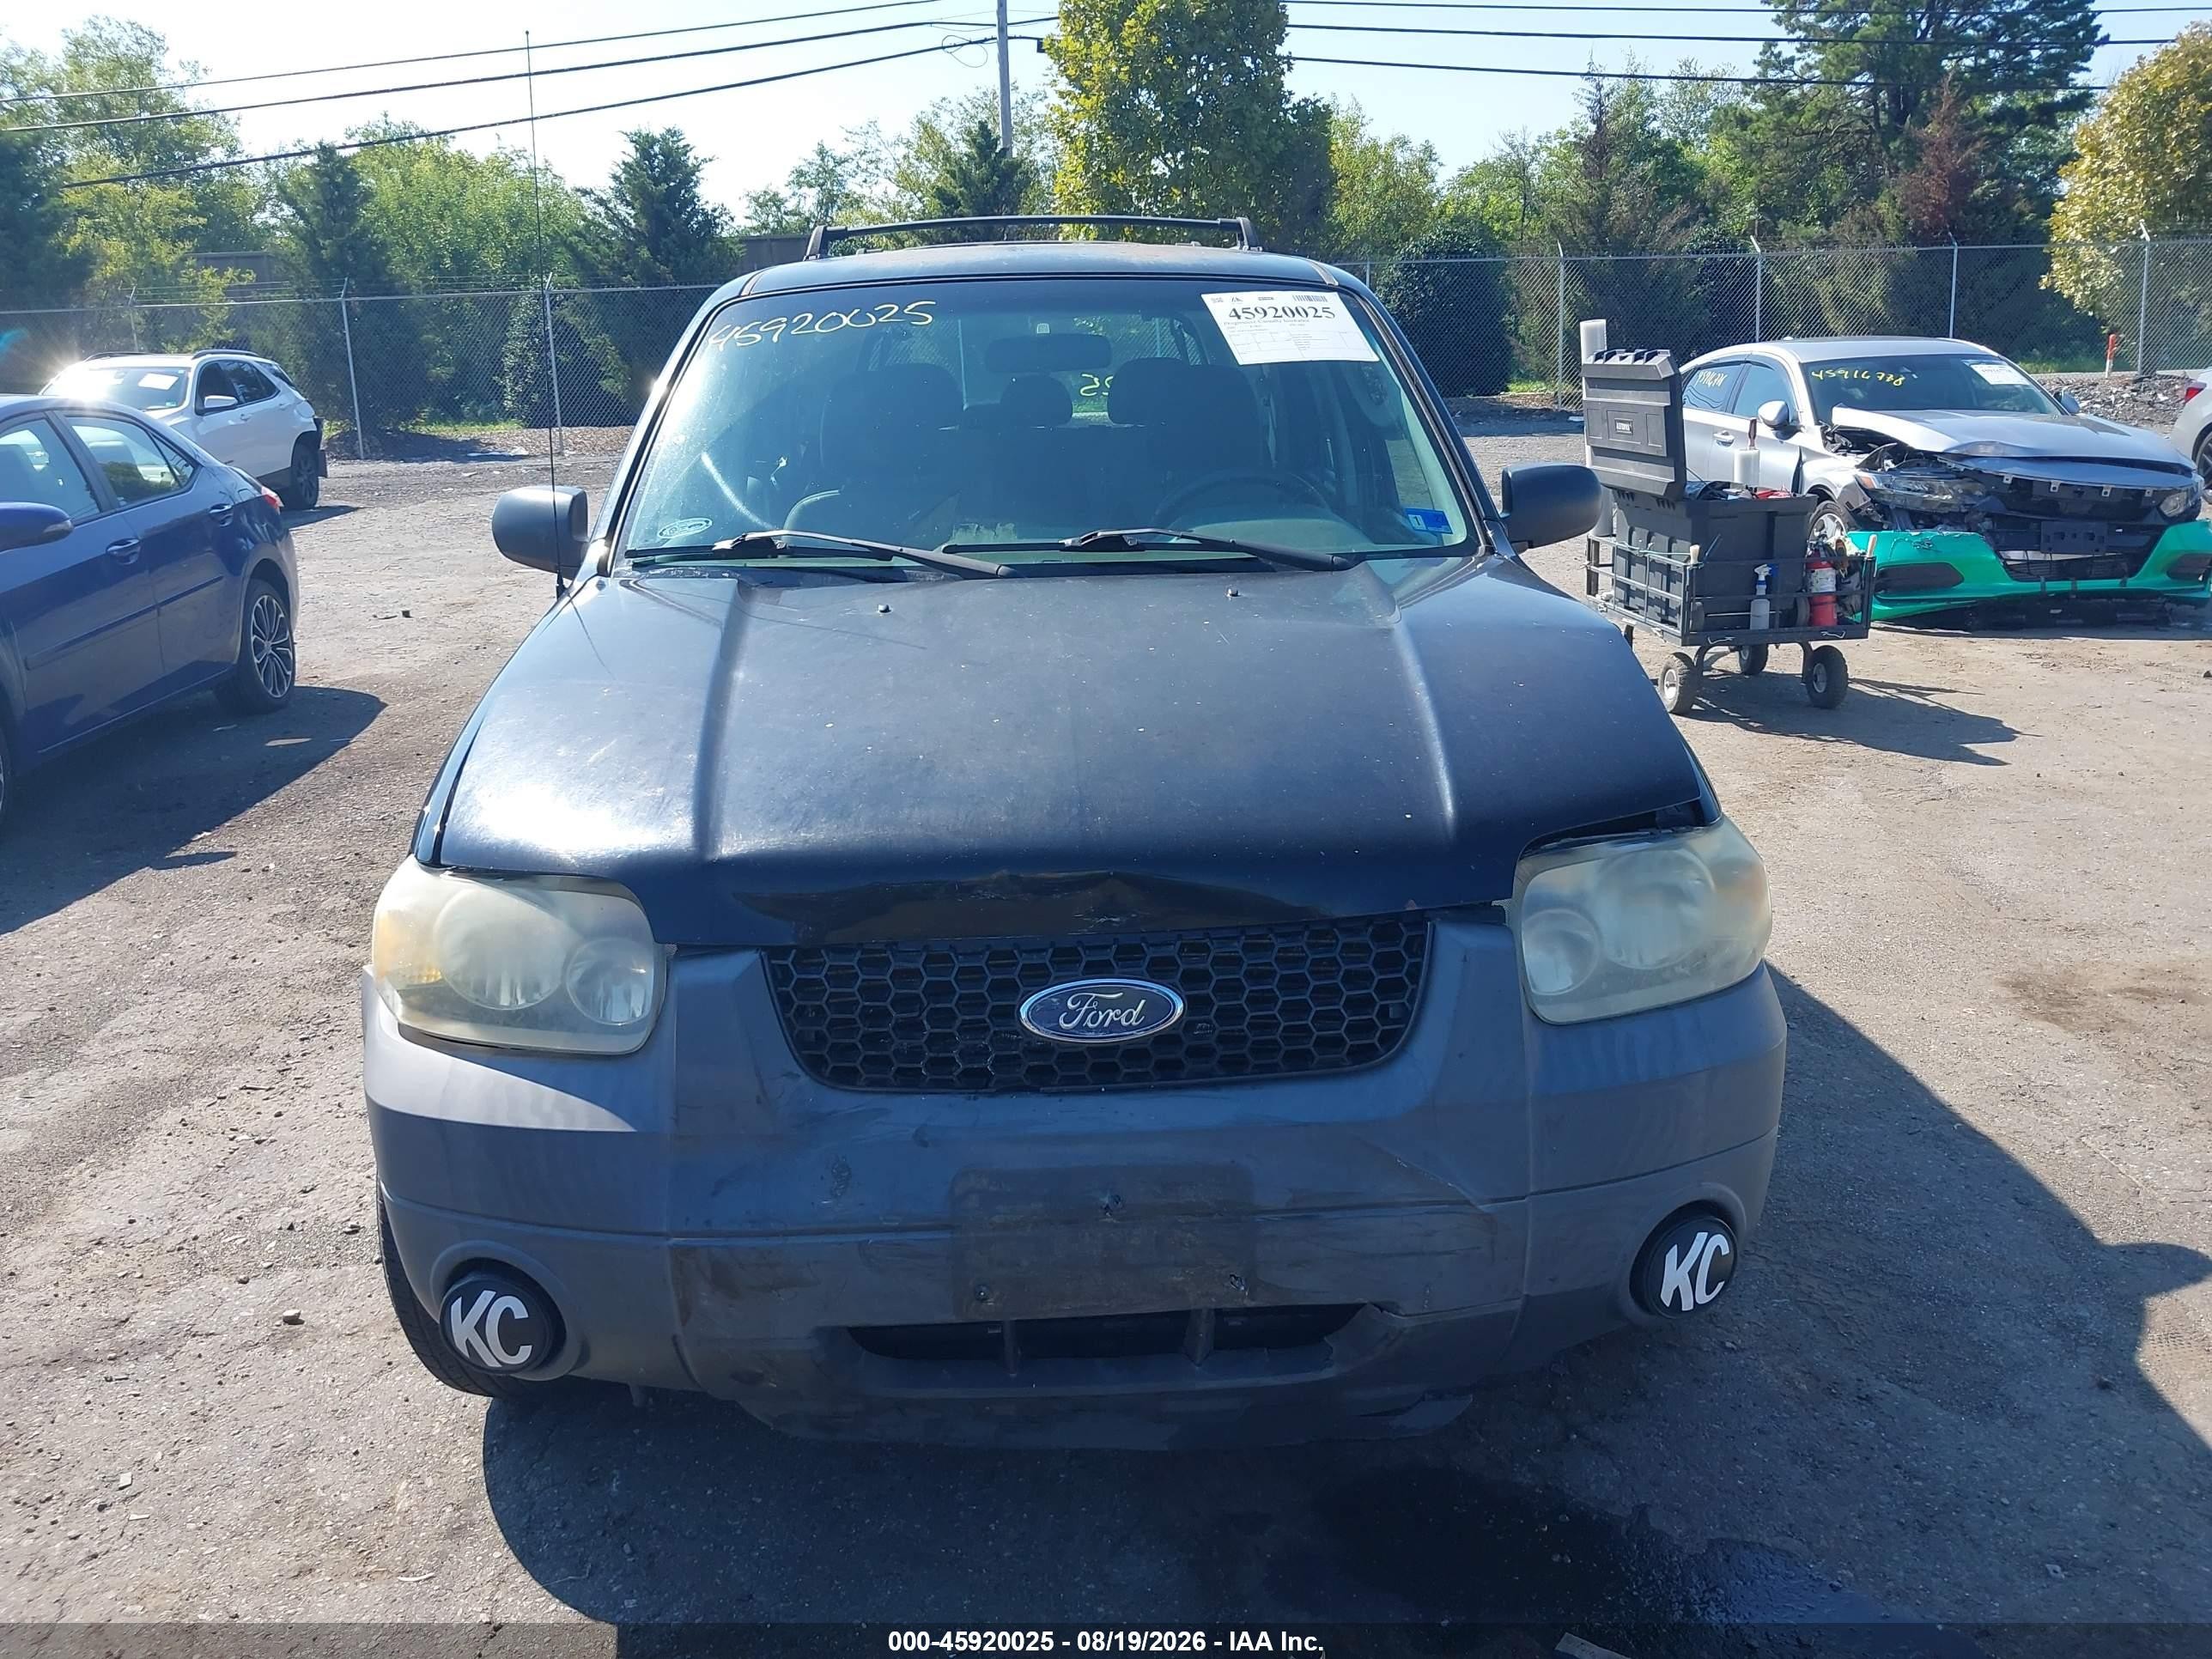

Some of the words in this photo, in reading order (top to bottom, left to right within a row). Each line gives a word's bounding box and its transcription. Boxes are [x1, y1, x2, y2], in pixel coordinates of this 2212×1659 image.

[708, 301, 936, 350] 45920025
[1229, 306, 1336, 320] 45920025
[1059, 992, 1146, 1030] Ford
[1660, 1231, 1730, 1311] KC
[450, 1289, 533, 1368] KC
